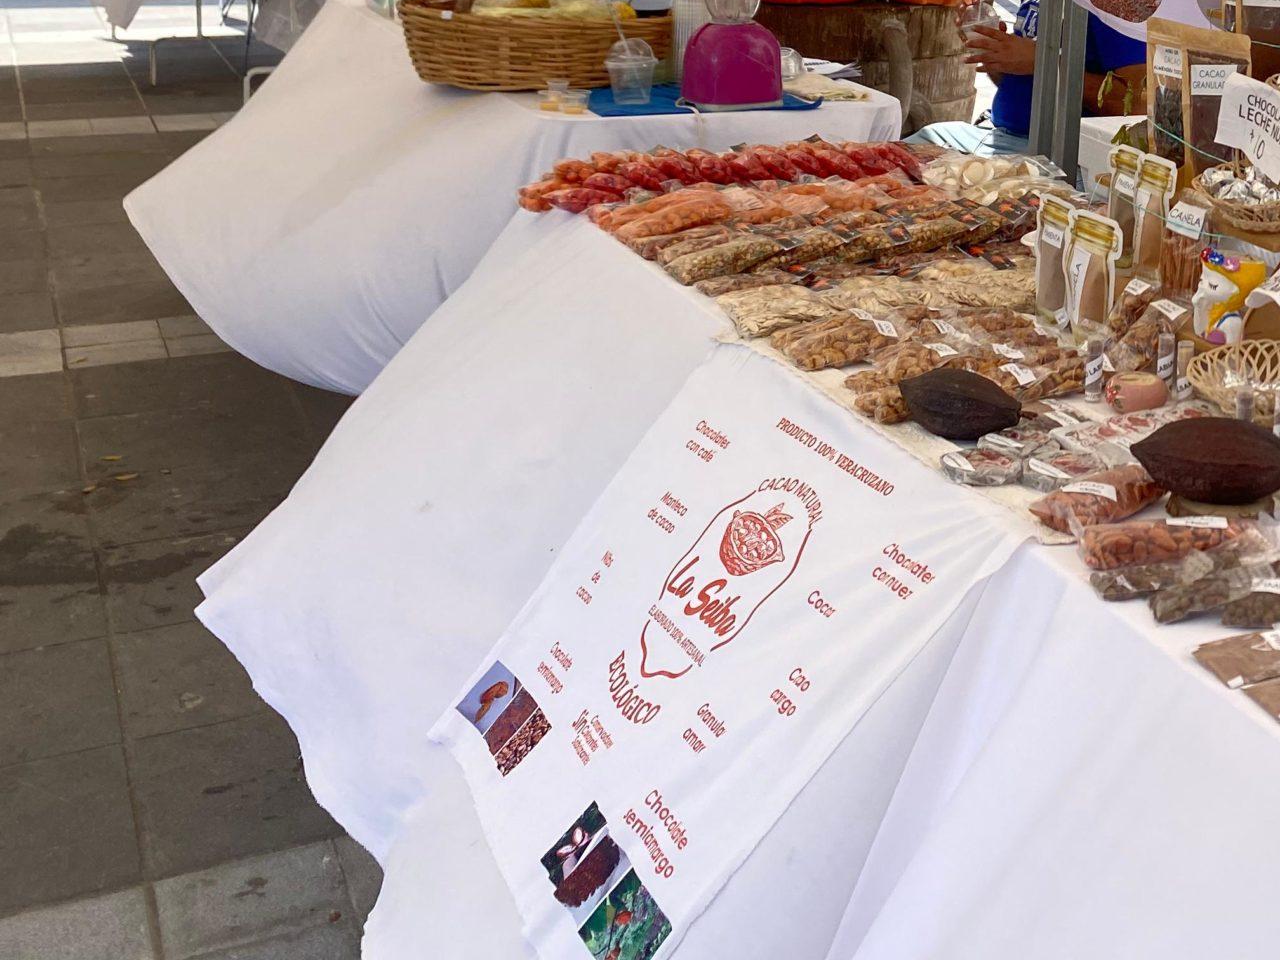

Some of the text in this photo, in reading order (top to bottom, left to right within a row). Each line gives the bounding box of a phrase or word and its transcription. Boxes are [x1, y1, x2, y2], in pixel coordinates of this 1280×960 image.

[1193, 80, 1225, 90] GRANULA
[1199, 69, 1226, 78] CACAO
[1238, 103, 1272, 133] LECHE
[1169, 208, 1201, 228] CANELA
[695, 420, 731, 450] Chocolates
[776, 417, 895, 497] PRODUCTO 100% VERACRUZANO
[647, 507, 658, 520] de
[758, 477, 823, 530] CACAO NATURAL
[666, 555, 741, 637] La Seiba
[648, 604, 675, 633] ELABORADO
[609, 650, 661, 725] ECOLÓGICO
[644, 789, 689, 850] Chocolate
[623, 808, 675, 879] semiamargo
